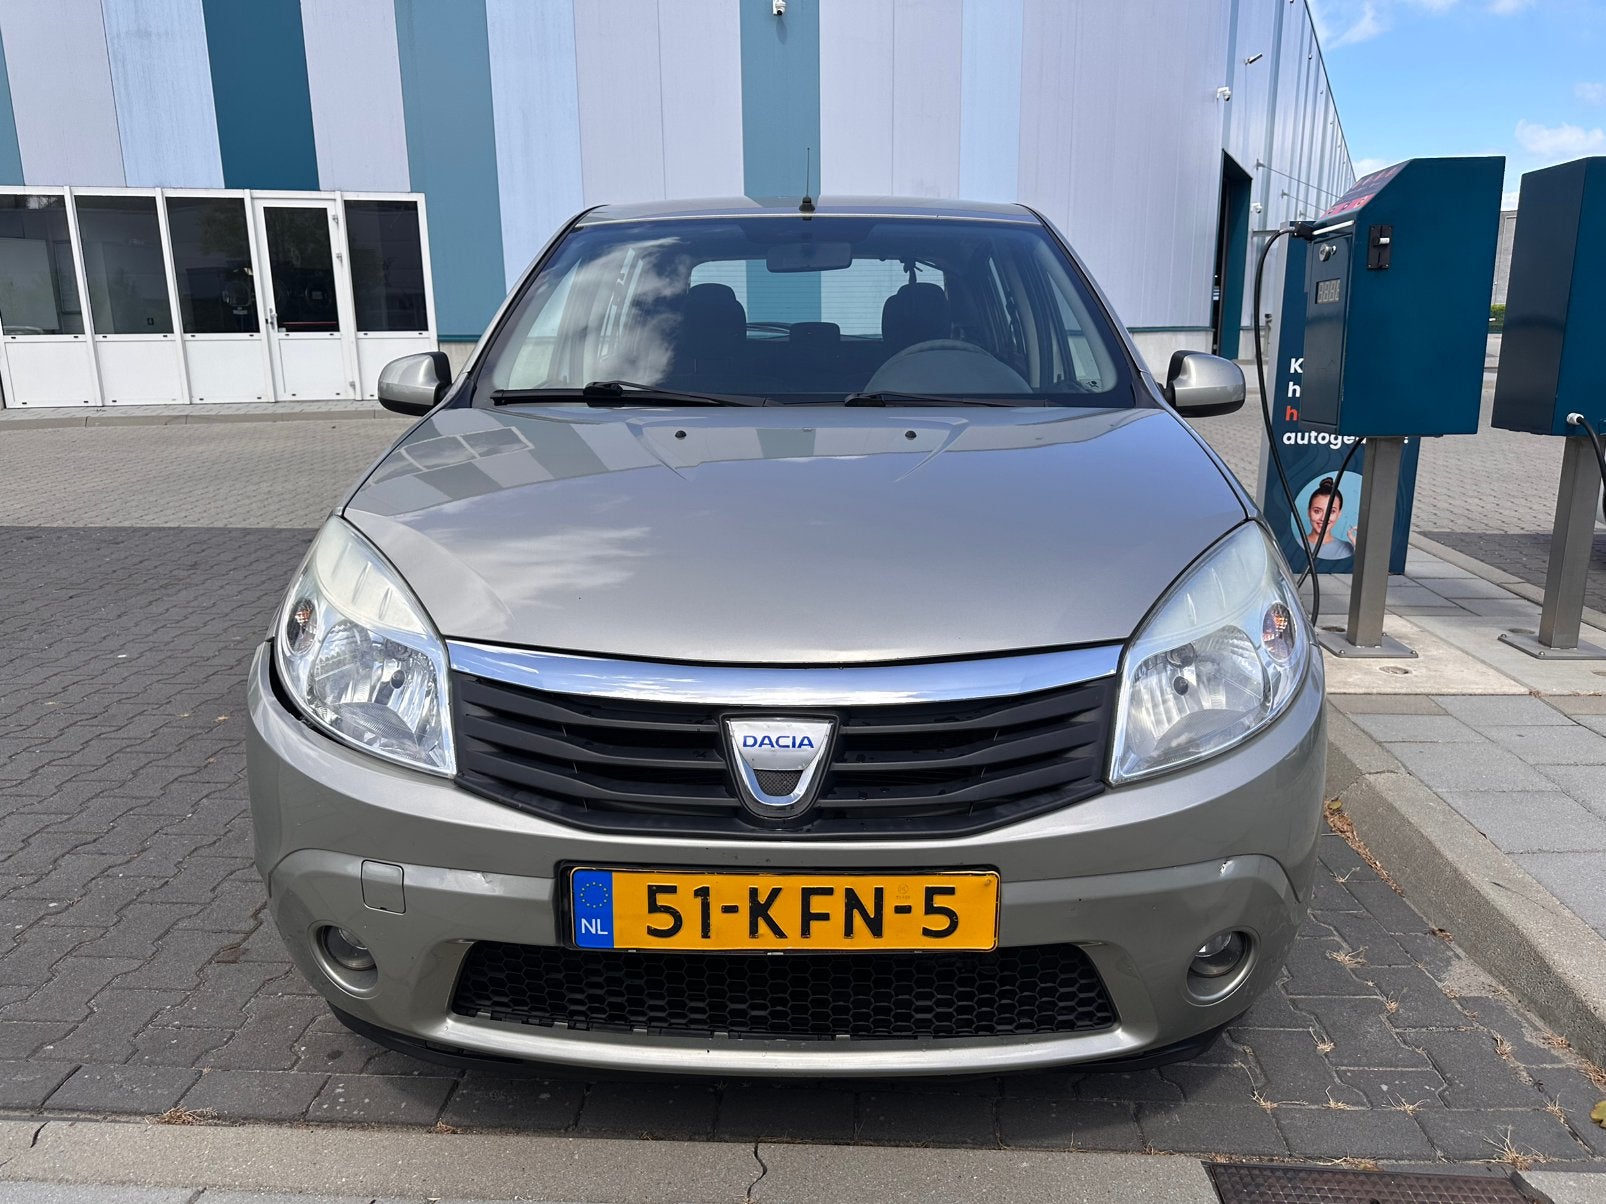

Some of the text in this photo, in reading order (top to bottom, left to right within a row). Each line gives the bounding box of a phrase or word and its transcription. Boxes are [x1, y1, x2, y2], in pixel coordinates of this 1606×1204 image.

[742, 735, 814, 749] DACIA
[646, 884, 959, 939] 51-KFN-5
[581, 918, 608, 935] NL
